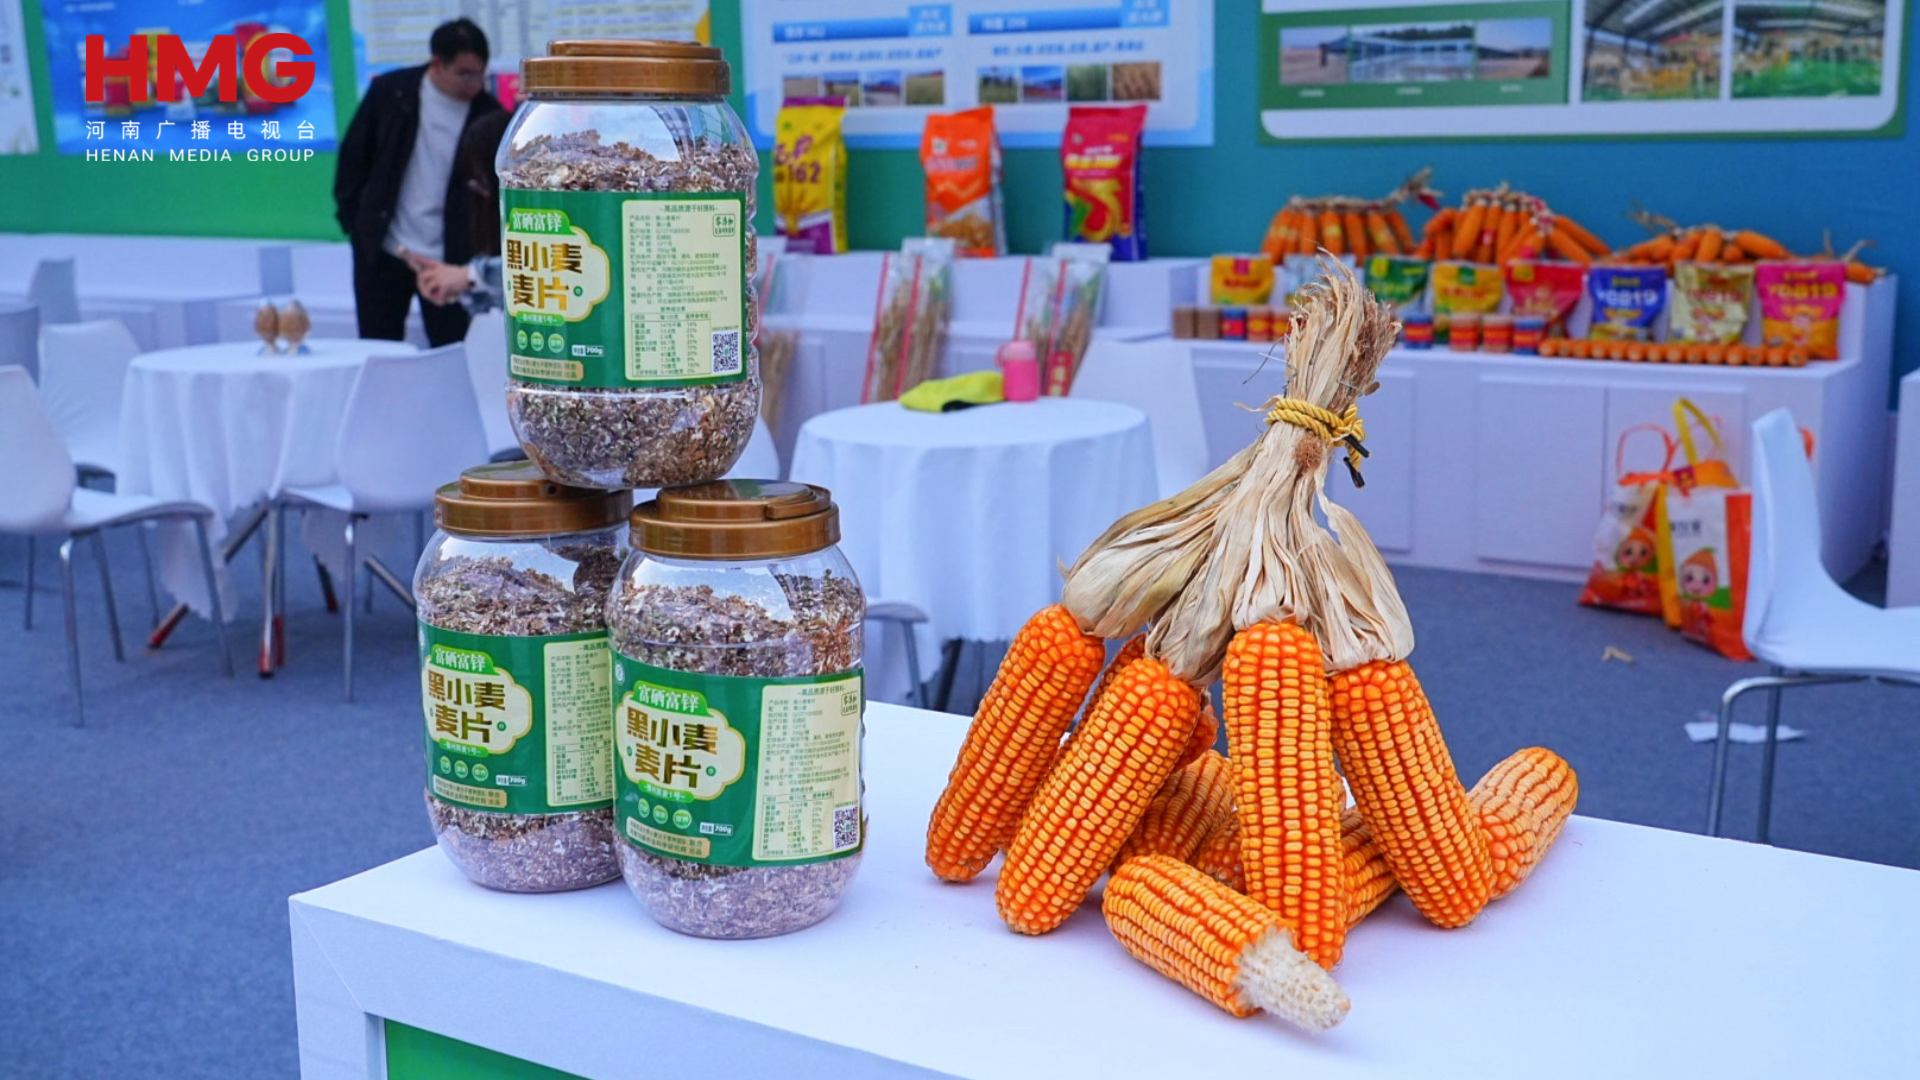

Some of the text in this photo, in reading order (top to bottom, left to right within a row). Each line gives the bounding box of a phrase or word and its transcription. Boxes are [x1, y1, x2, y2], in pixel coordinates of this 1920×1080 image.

[512, 211, 562, 232] 富硒富锌
[507, 239, 582, 274] 黑小麦
[513, 274, 569, 311] 麦片
[586, 347, 603, 355] 700g
[435, 648, 486, 672] 富硒富锌
[428, 669, 505, 711] 黑小麦
[638, 684, 700, 713] 富硒富锌
[435, 704, 492, 743] 麦片
[627, 706, 718, 755] 黑小麦
[635, 743, 701, 788] 麦片
[714, 826, 732, 834] 700g
